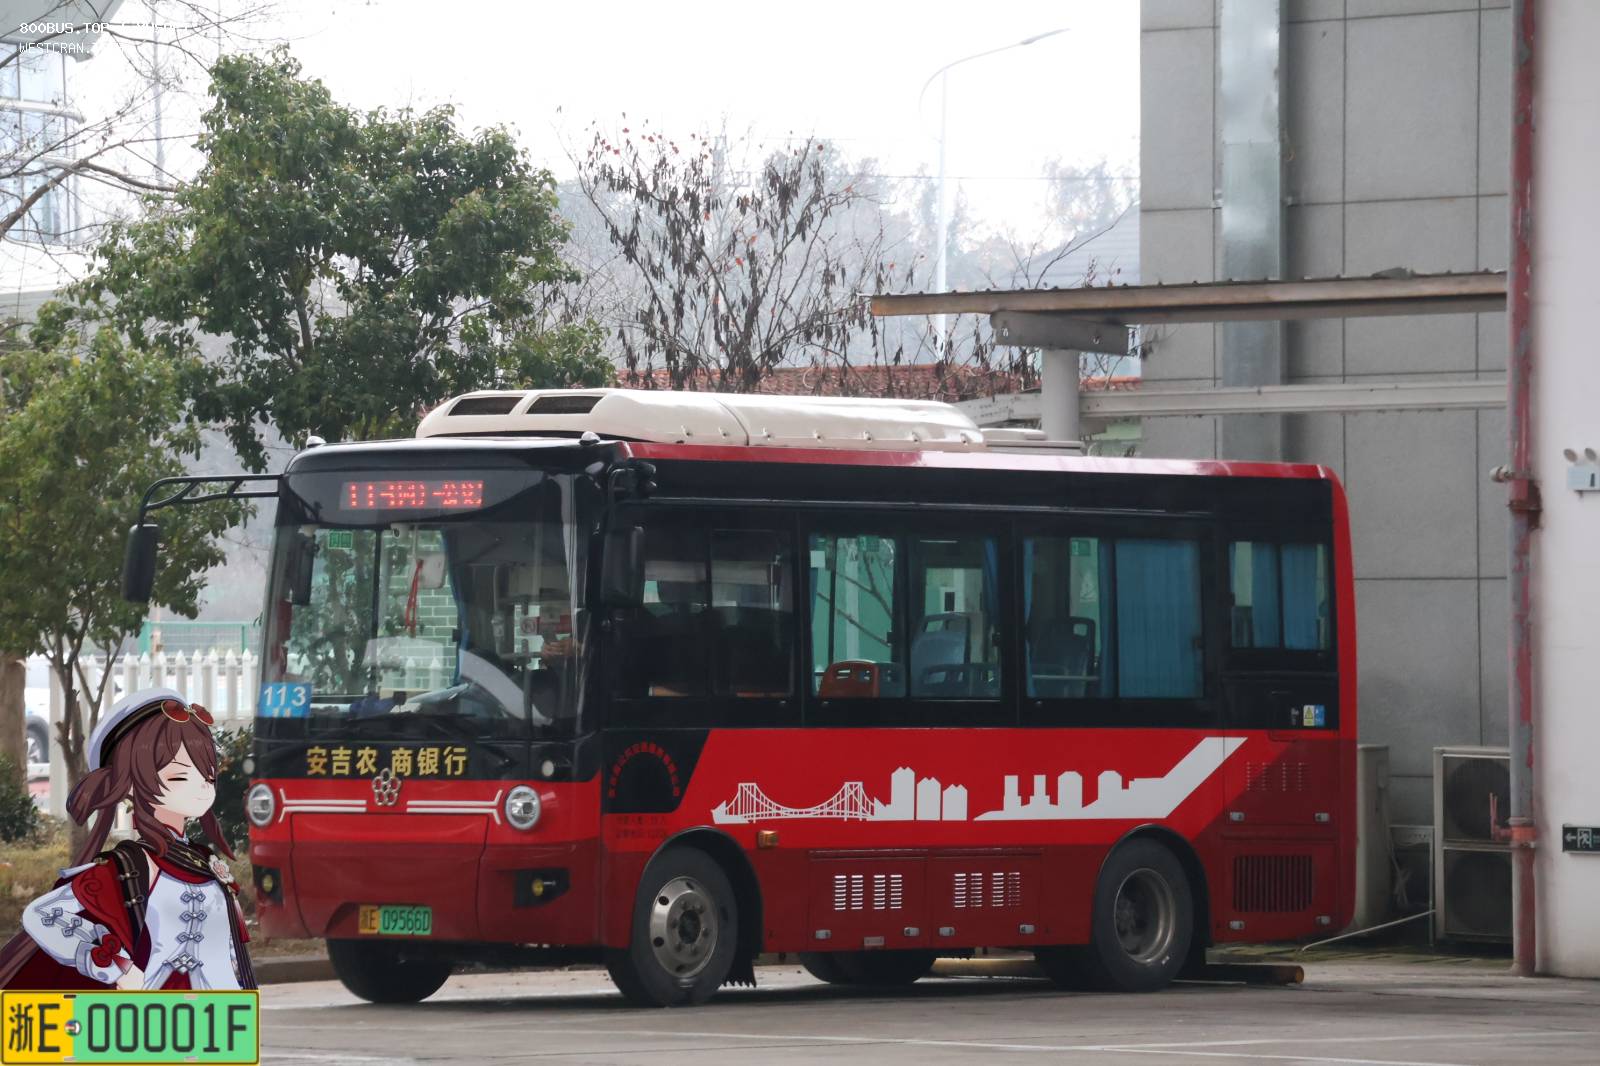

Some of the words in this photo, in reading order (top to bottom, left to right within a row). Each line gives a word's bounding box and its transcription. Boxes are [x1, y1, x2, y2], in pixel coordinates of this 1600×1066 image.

[264, 686, 306, 706] 113
[306, 746, 467, 776] 安吉农商银行
